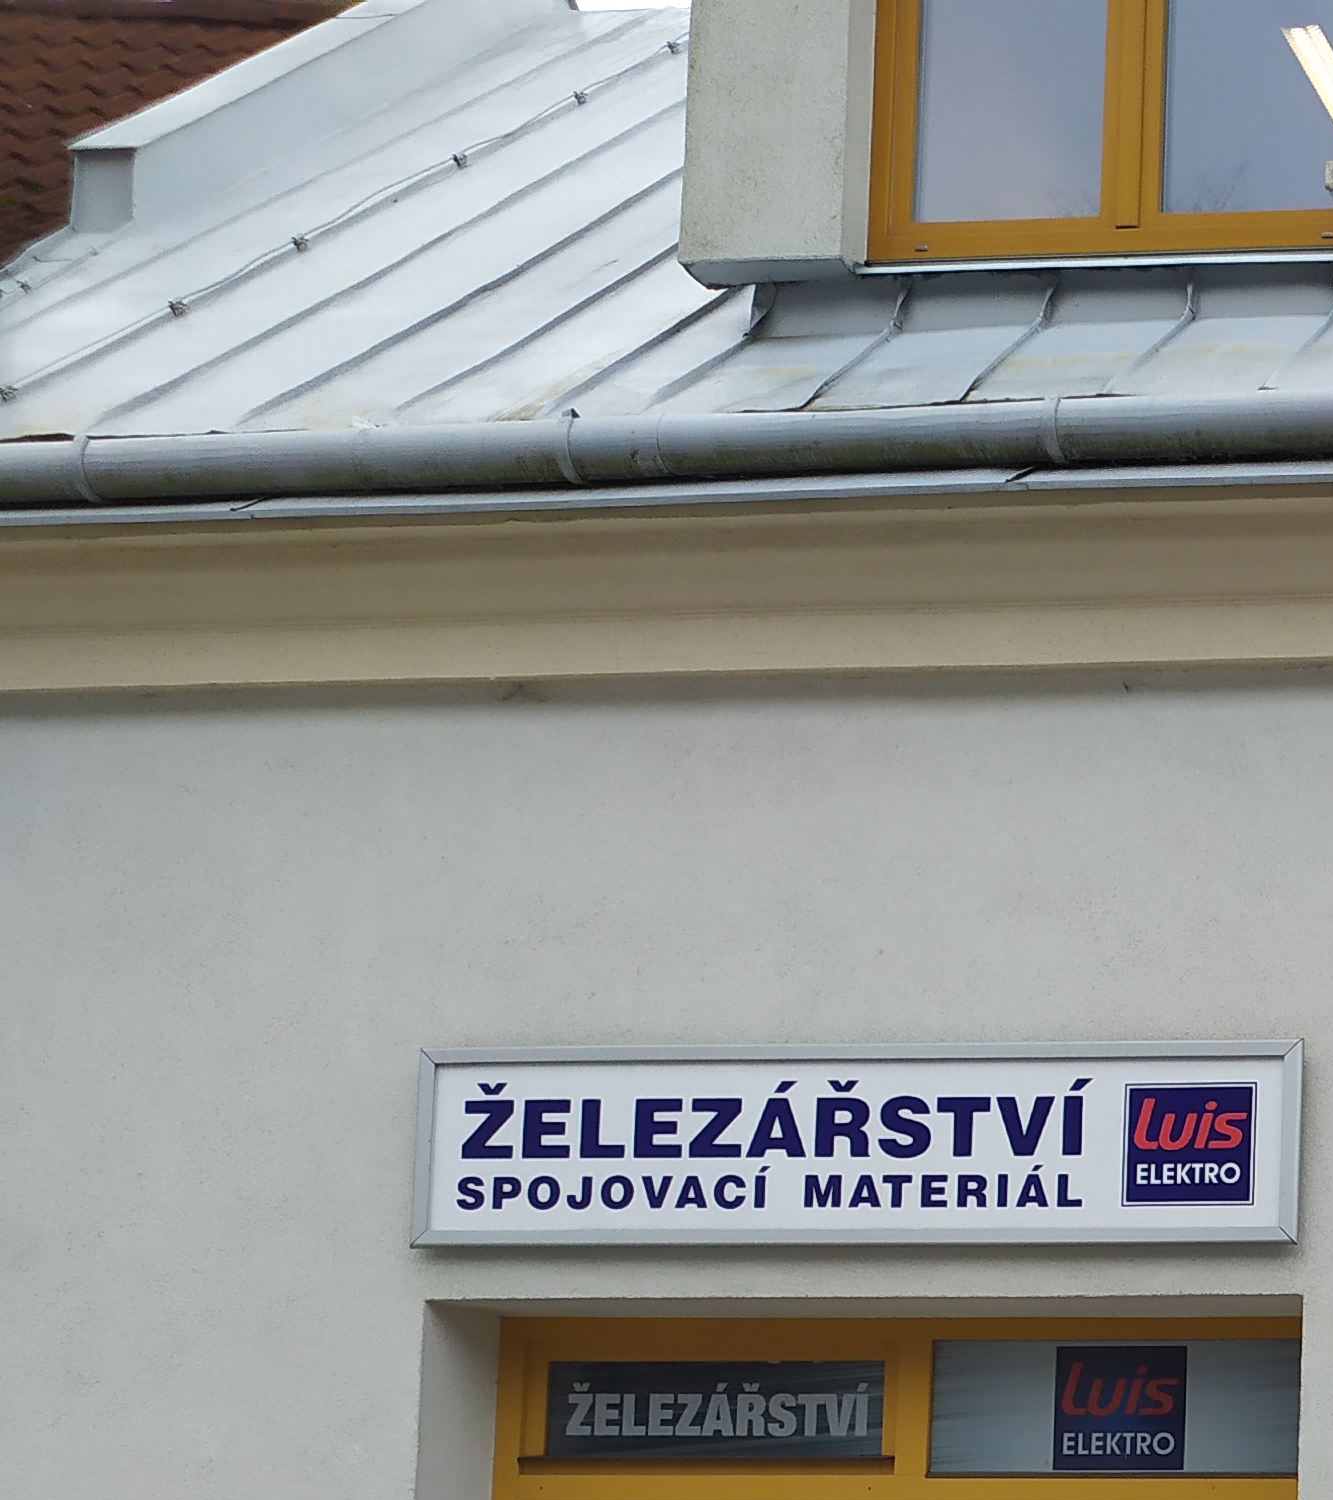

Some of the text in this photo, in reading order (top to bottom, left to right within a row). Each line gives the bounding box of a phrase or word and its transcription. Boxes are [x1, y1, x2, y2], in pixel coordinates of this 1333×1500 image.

[460, 1078, 1094, 1160] ŽELEZÁŘSTVÍ
[456, 1165, 1084, 1211] SPOJOVACÍ MATERIÁL
[1135, 1161, 1241, 1187] ELEKTRO
[565, 1381, 870, 1437] ŽELEZÁŘSTVÍ
[1062, 1432, 1175, 1456] ELEKTRO
